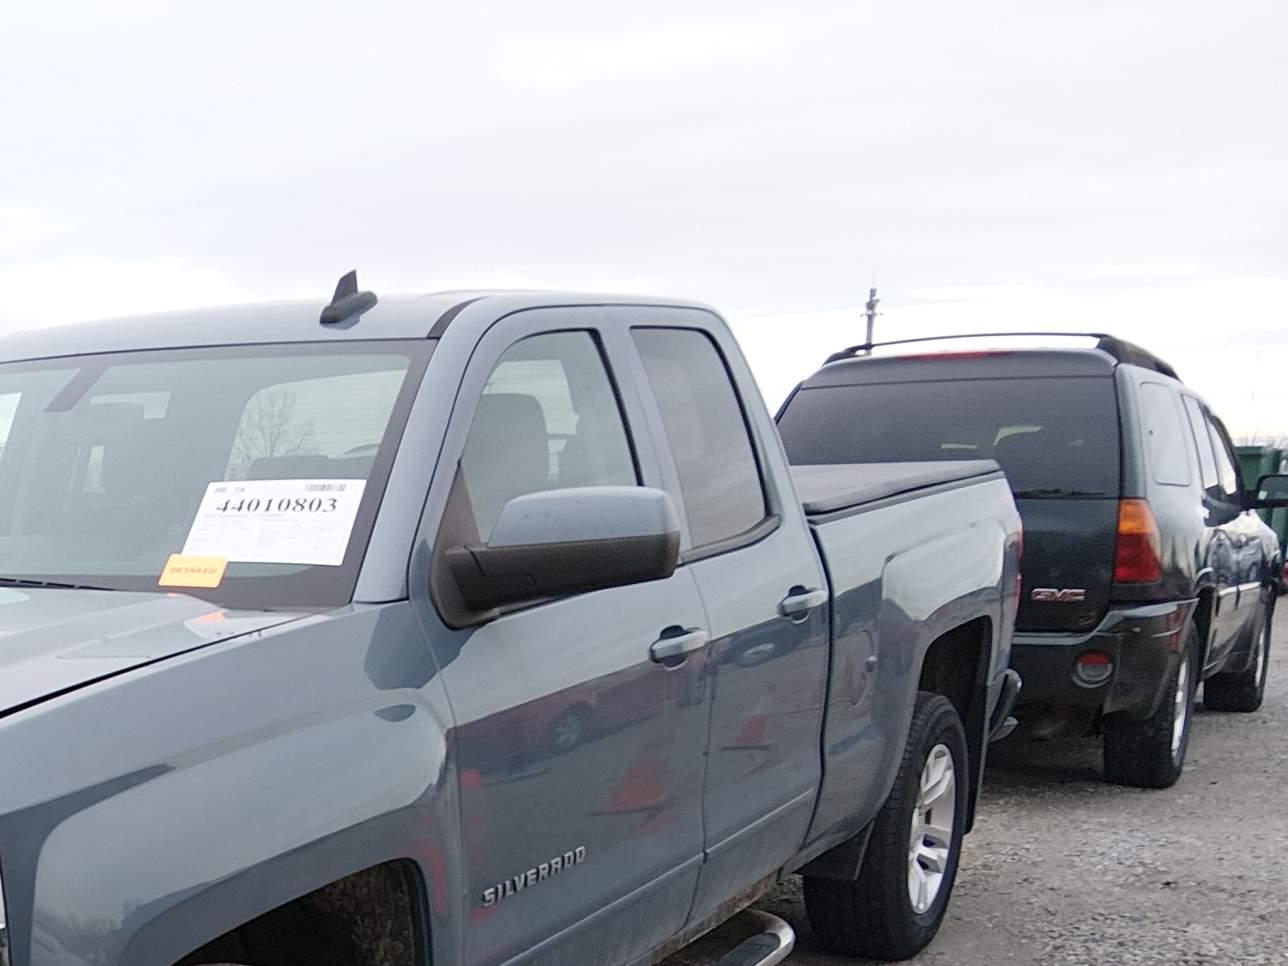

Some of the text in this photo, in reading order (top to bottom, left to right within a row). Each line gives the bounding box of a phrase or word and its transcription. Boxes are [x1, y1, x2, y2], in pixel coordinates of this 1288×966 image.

[216, 498, 338, 513] 44010803
[1031, 588, 1088, 602] GMC
[481, 845, 587, 908] SILVERADO
